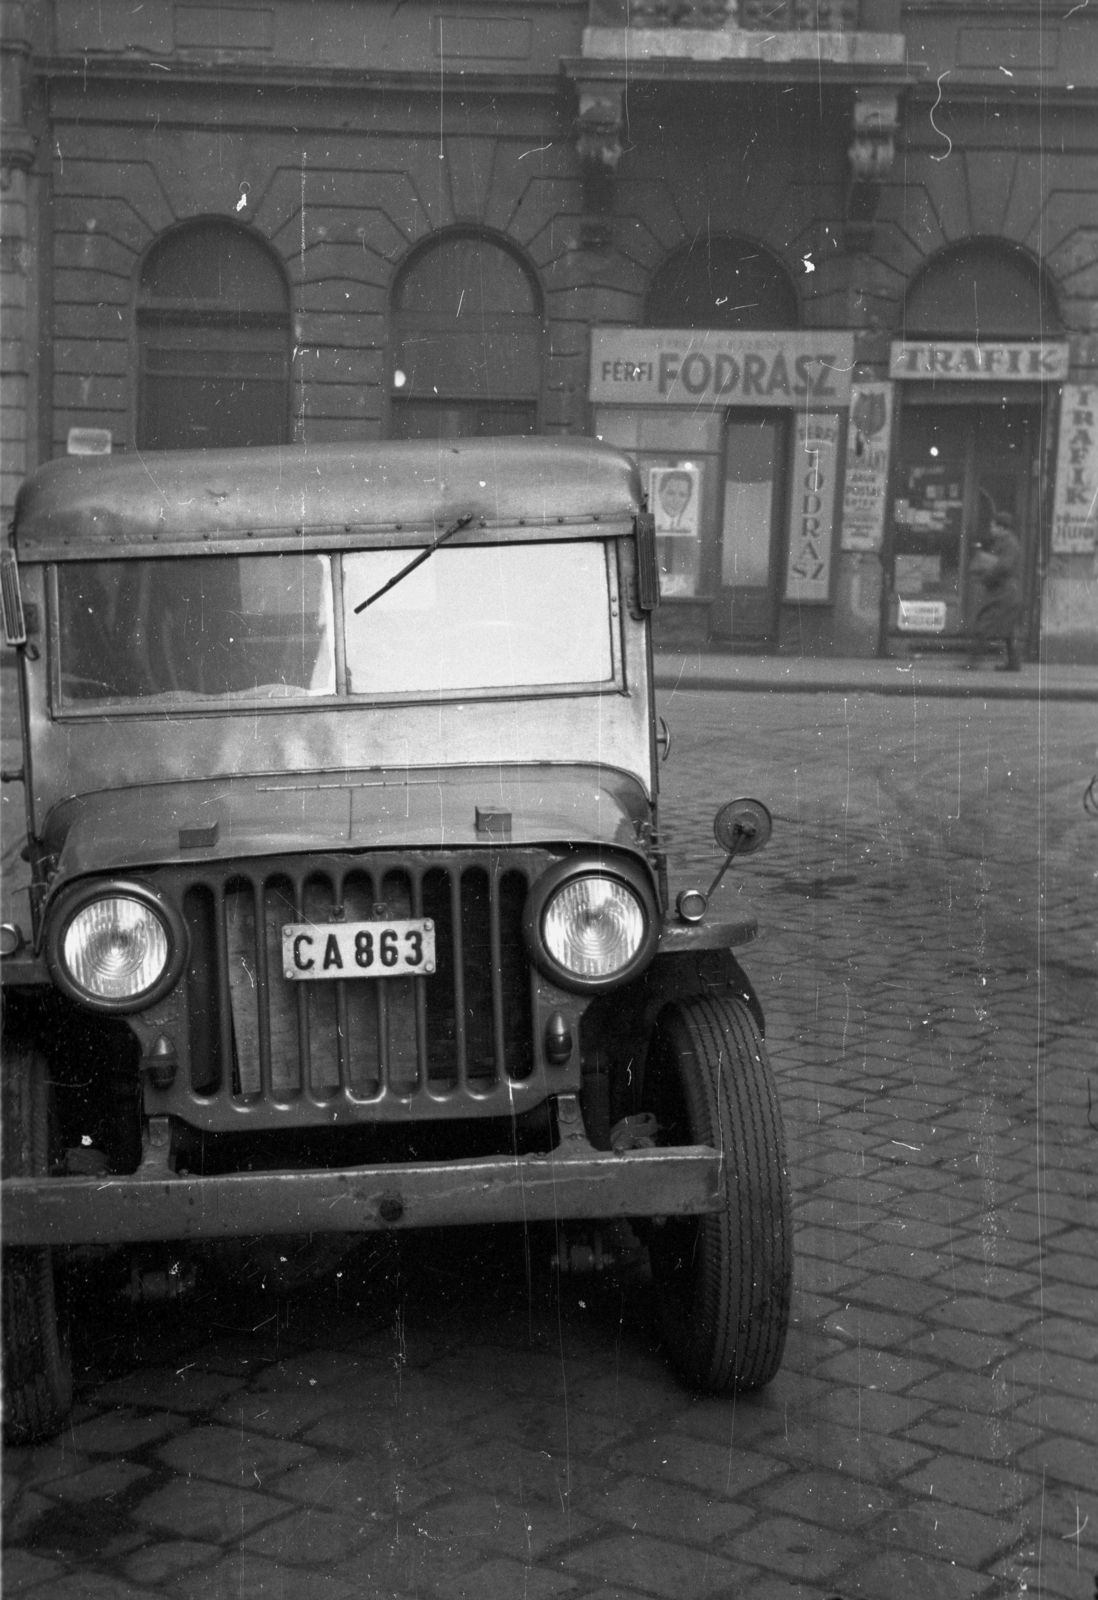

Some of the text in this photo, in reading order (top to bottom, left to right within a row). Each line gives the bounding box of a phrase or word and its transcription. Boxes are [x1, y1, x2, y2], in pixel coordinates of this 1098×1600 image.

[658, 350, 837, 396] FODRÁSZ
[903, 347, 1062, 374] TRAFIK
[1065, 389, 1094, 505] TRAFIK
